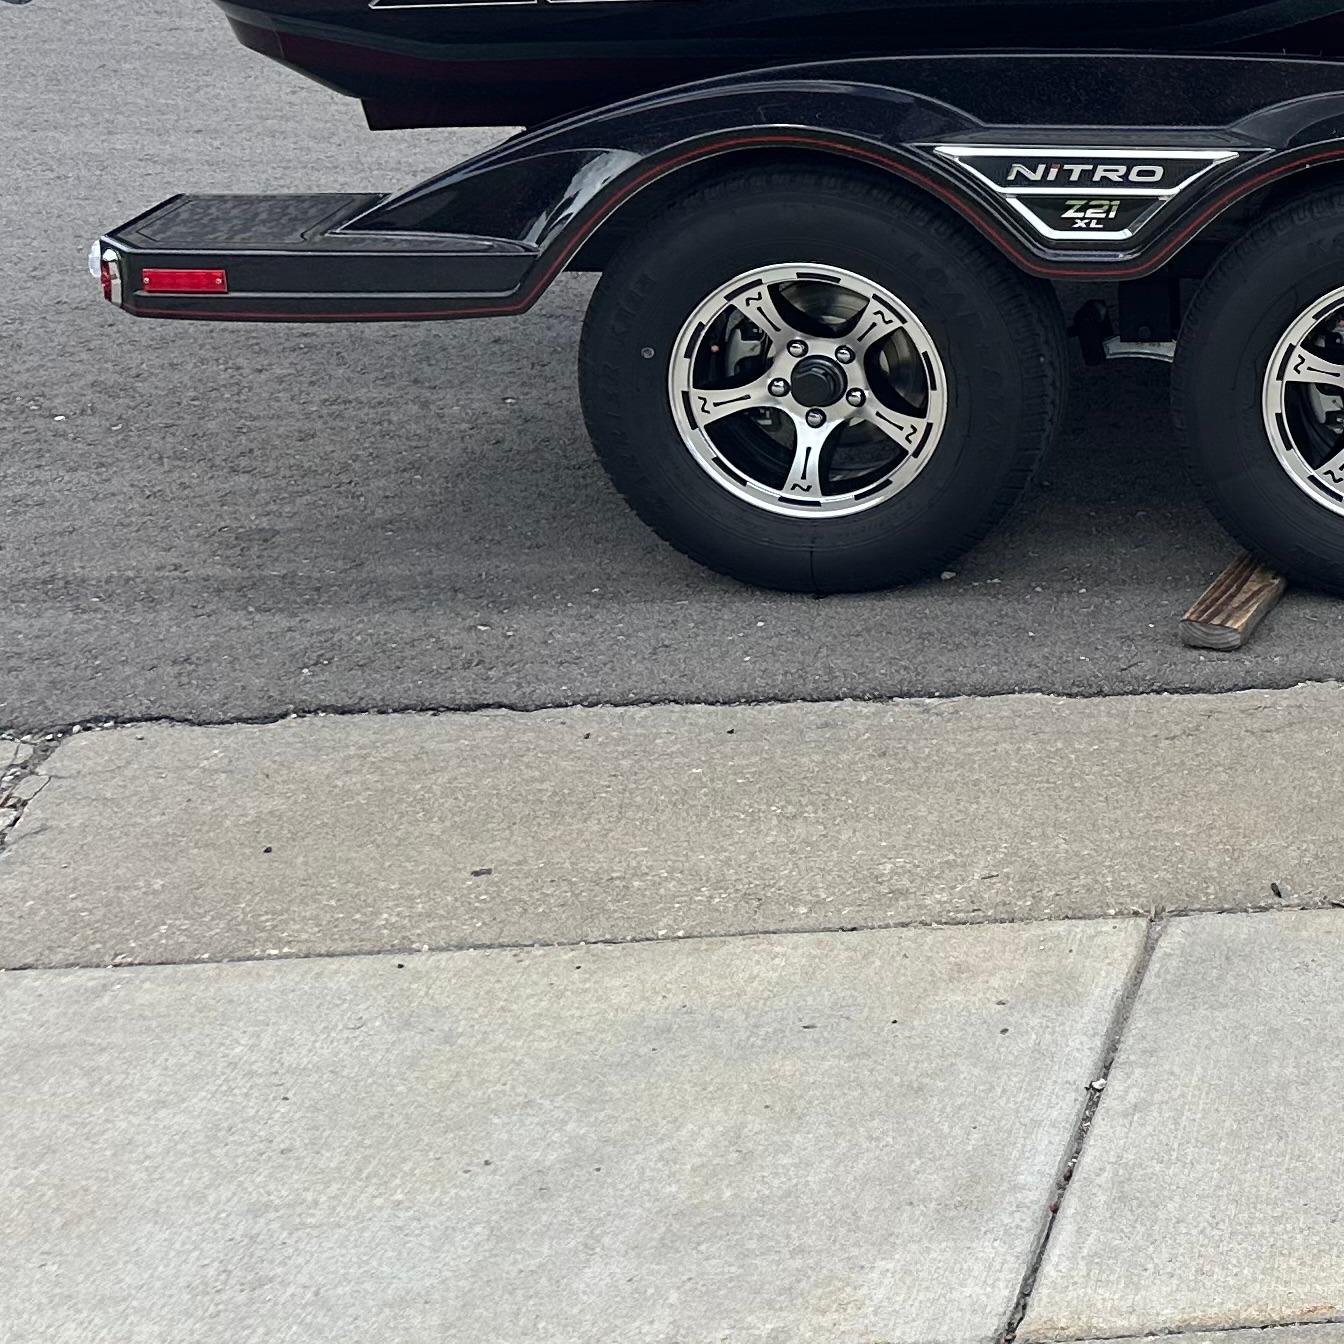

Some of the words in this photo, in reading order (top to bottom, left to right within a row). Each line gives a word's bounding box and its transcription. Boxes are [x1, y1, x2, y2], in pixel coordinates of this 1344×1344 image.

[1007, 163, 1165, 183] NITRO
[1059, 199, 1121, 219] Z21
[1071, 219, 1105, 229] XL
